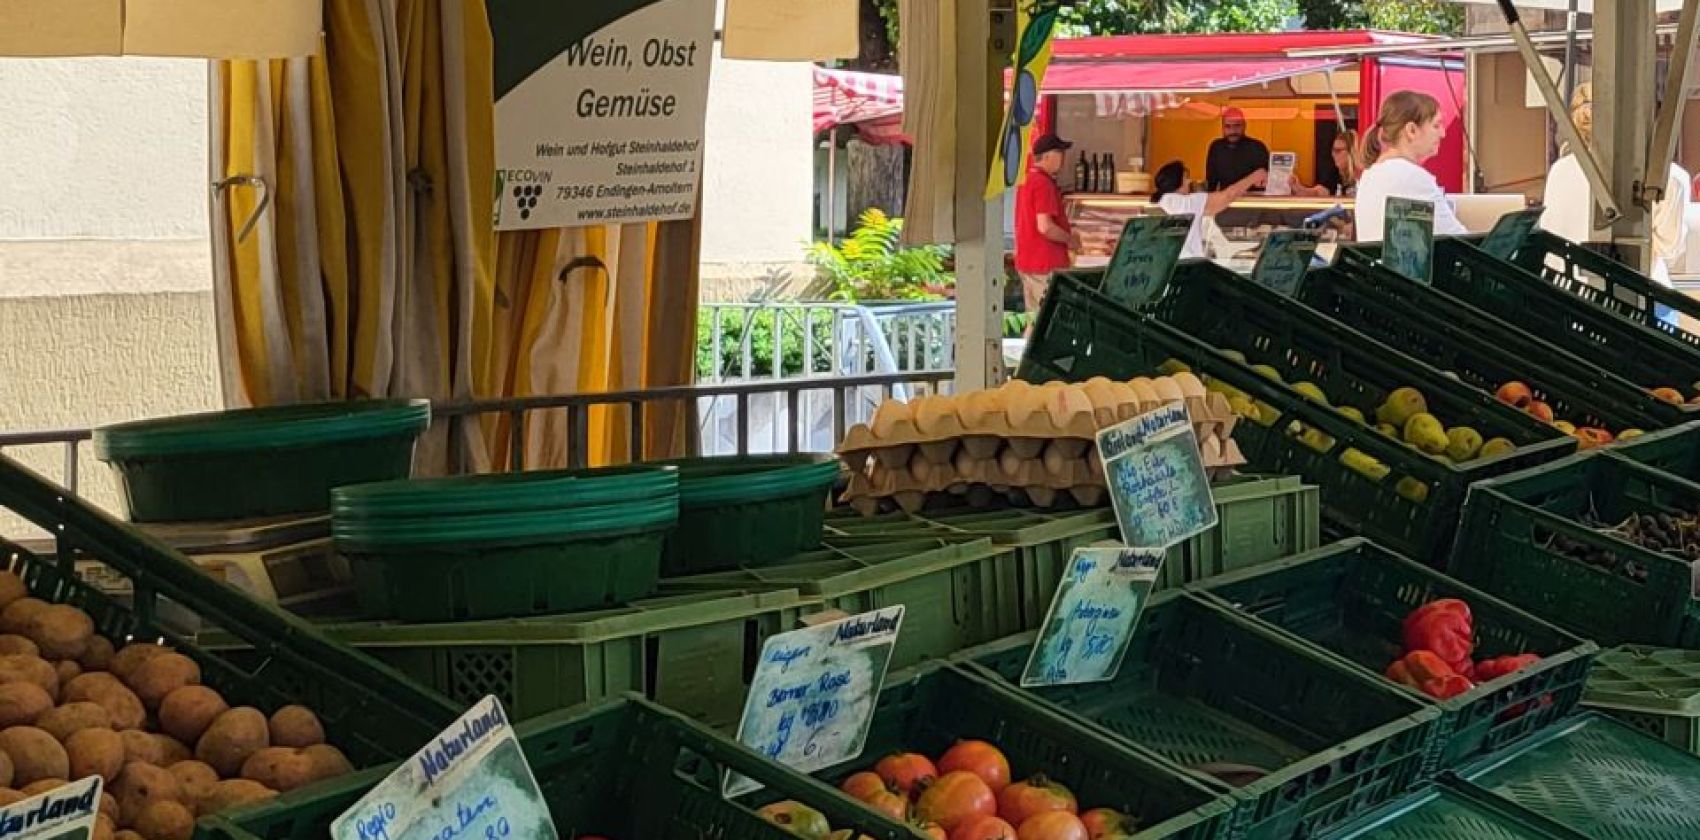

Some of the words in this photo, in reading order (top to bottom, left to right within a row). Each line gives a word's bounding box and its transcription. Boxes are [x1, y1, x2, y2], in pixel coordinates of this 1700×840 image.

[567, 38, 632, 73] Wein,
[643, 38, 696, 66] Obst
[576, 88, 675, 117] Gemüse
[536, 143, 563, 156] Wein
[567, 144, 587, 155] und
[590, 142, 626, 156] Hofgut
[629, 139, 698, 153] Steinhaldehof
[507, 170, 552, 182] ECOVIN
[616, 161, 687, 176] Steinhaldehof
[556, 185, 593, 199] 79346
[577, 203, 691, 220] www.steinhaldehof.de
[418, 697, 506, 784] Naturland
[0, 778, 99, 836] turland
